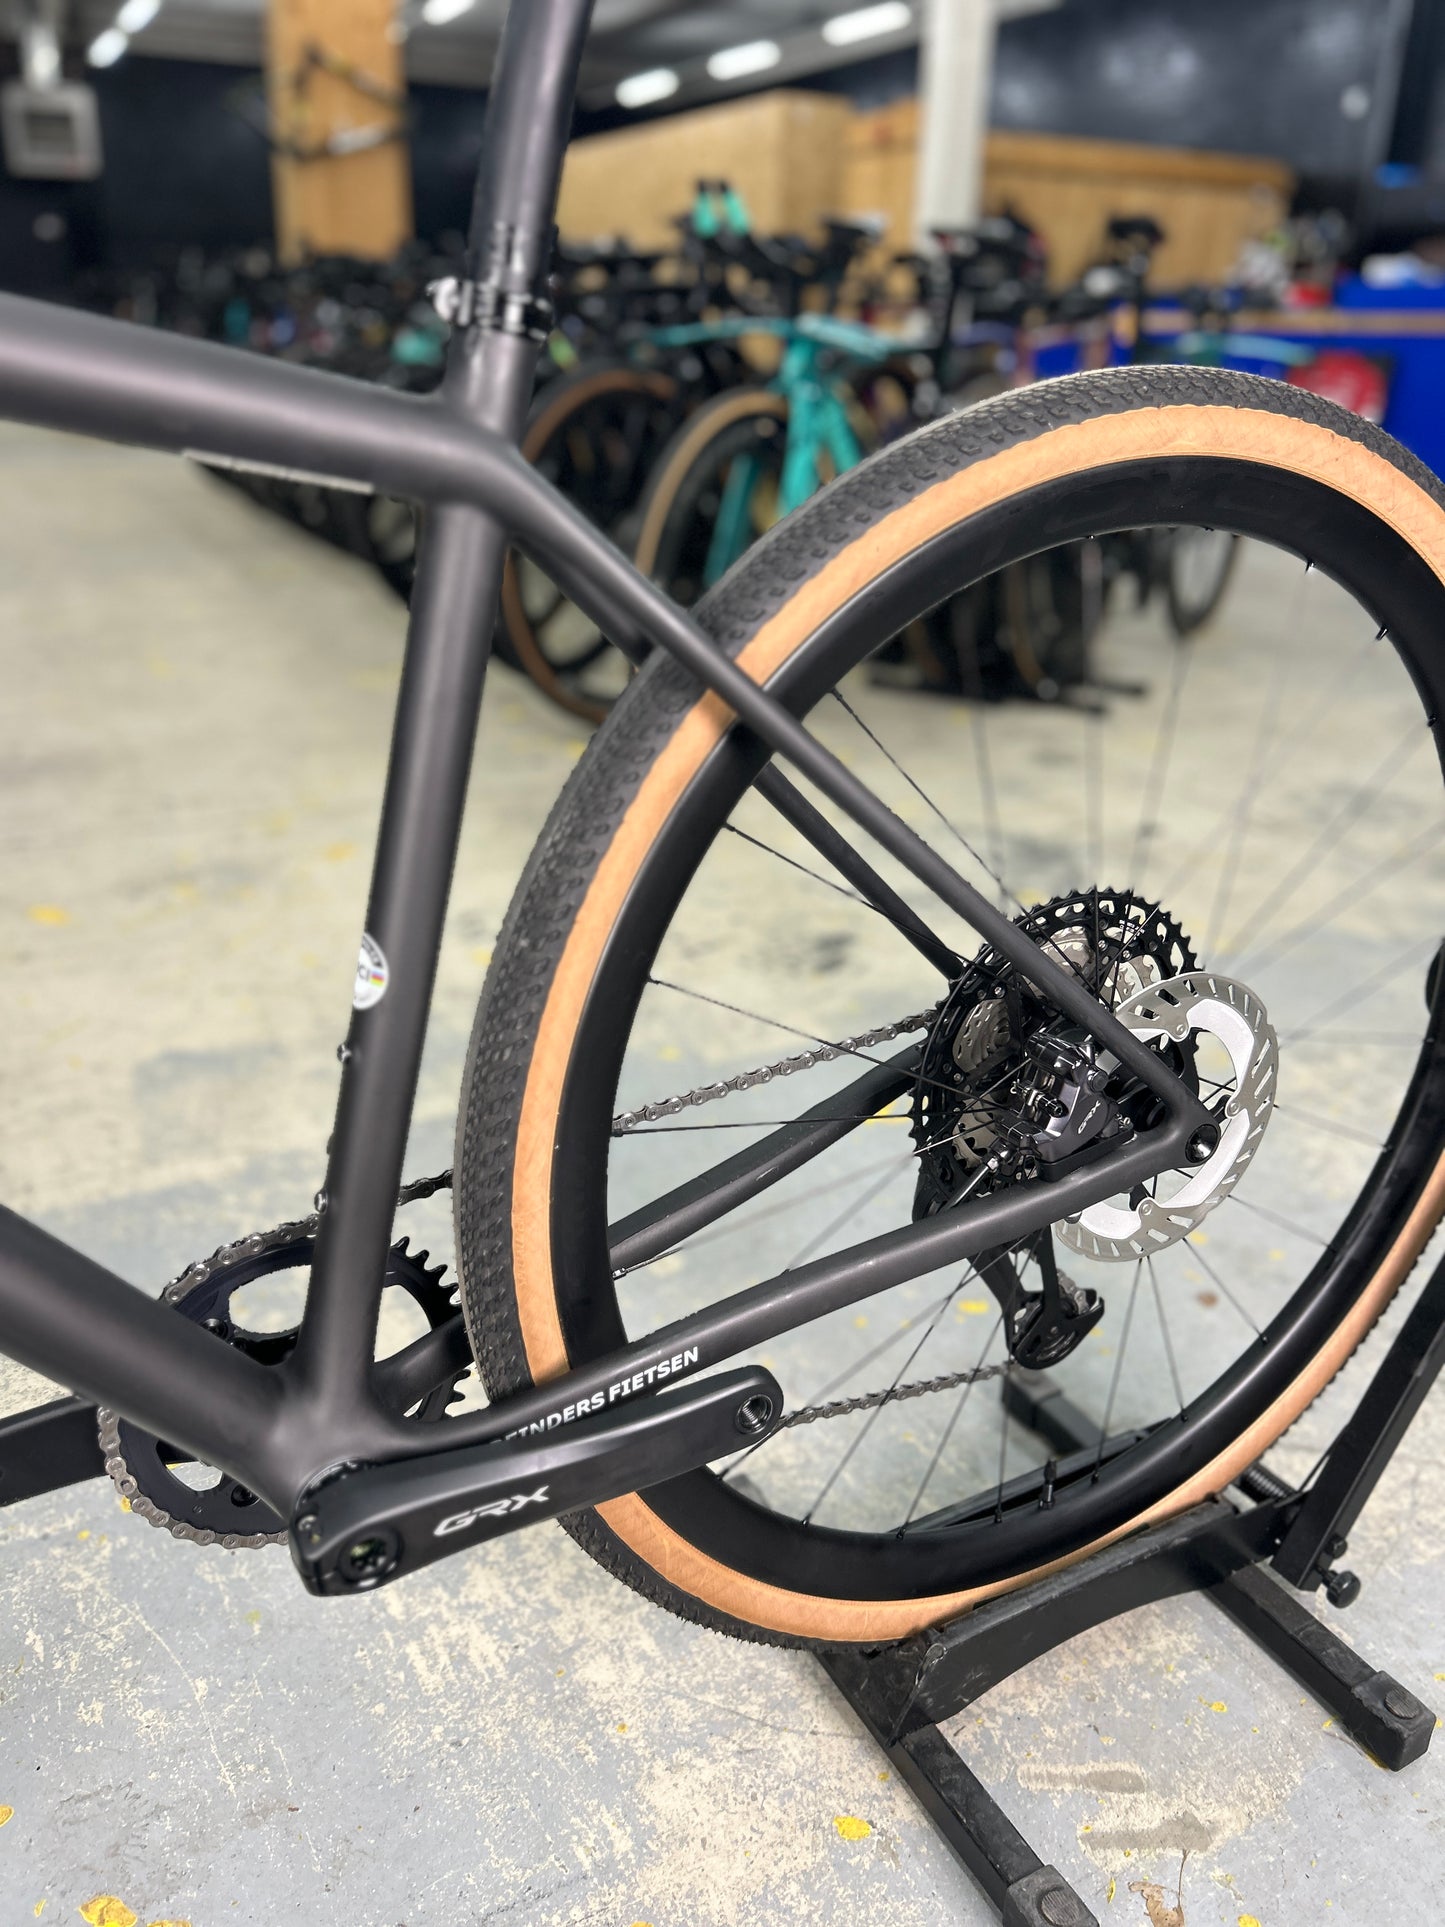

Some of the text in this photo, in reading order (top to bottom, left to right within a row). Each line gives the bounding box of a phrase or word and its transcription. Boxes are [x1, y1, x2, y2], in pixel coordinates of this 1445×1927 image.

[1077, 1100, 1101, 1134] GRX
[609, 1346, 699, 1403] FIETSEN
[433, 1485, 550, 1536] GRX
